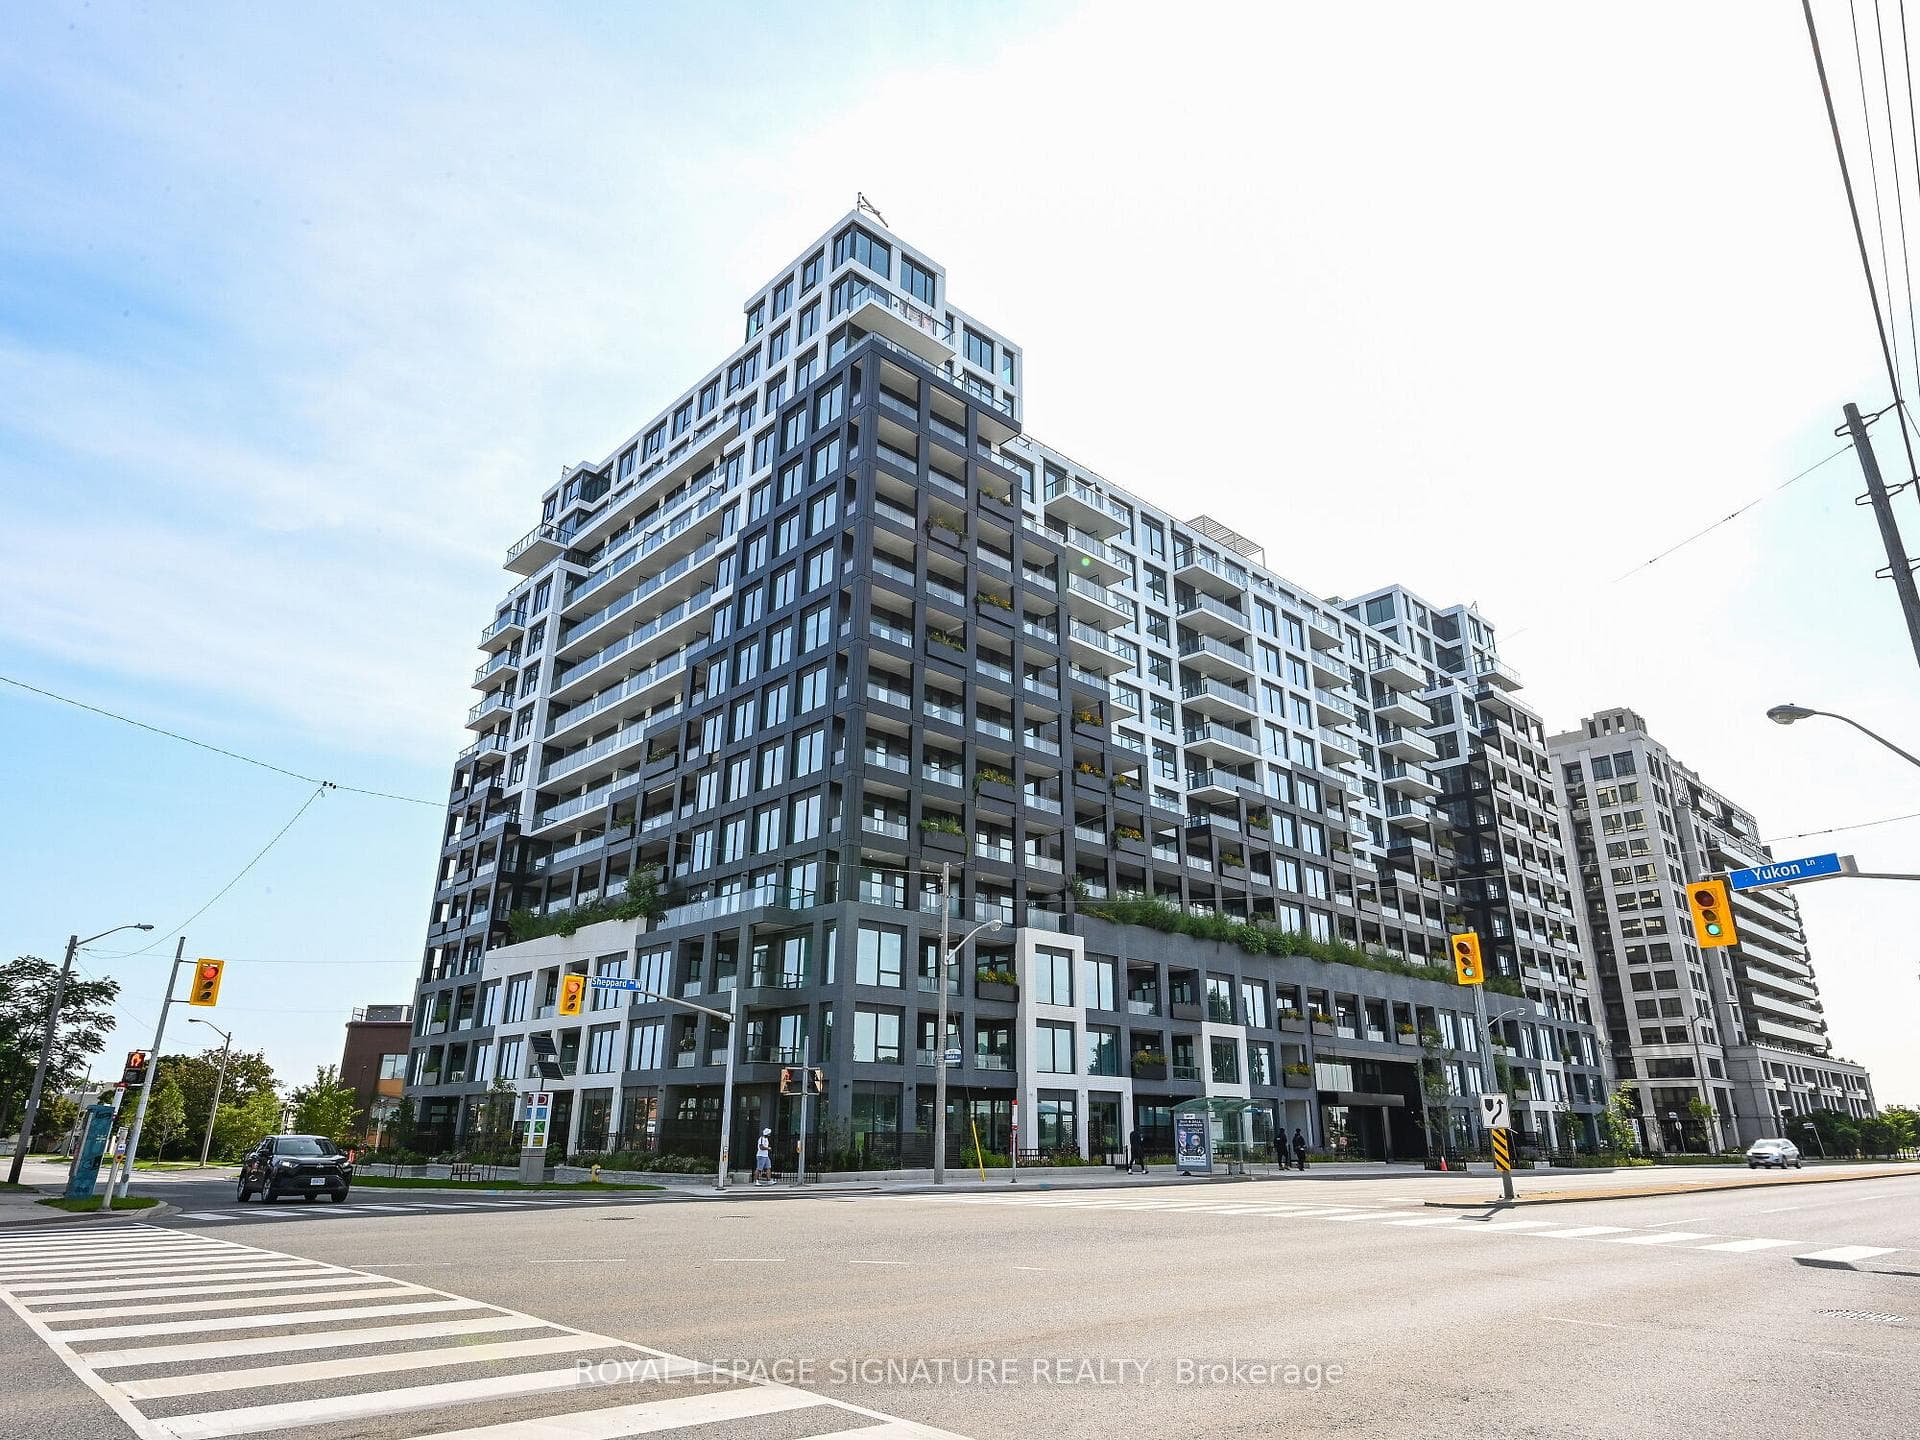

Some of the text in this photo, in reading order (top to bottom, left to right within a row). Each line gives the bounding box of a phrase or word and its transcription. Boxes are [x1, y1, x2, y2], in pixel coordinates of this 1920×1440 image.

[1751, 859, 1816, 881] Yukon Ln
[592, 977, 627, 988] Sheppard
